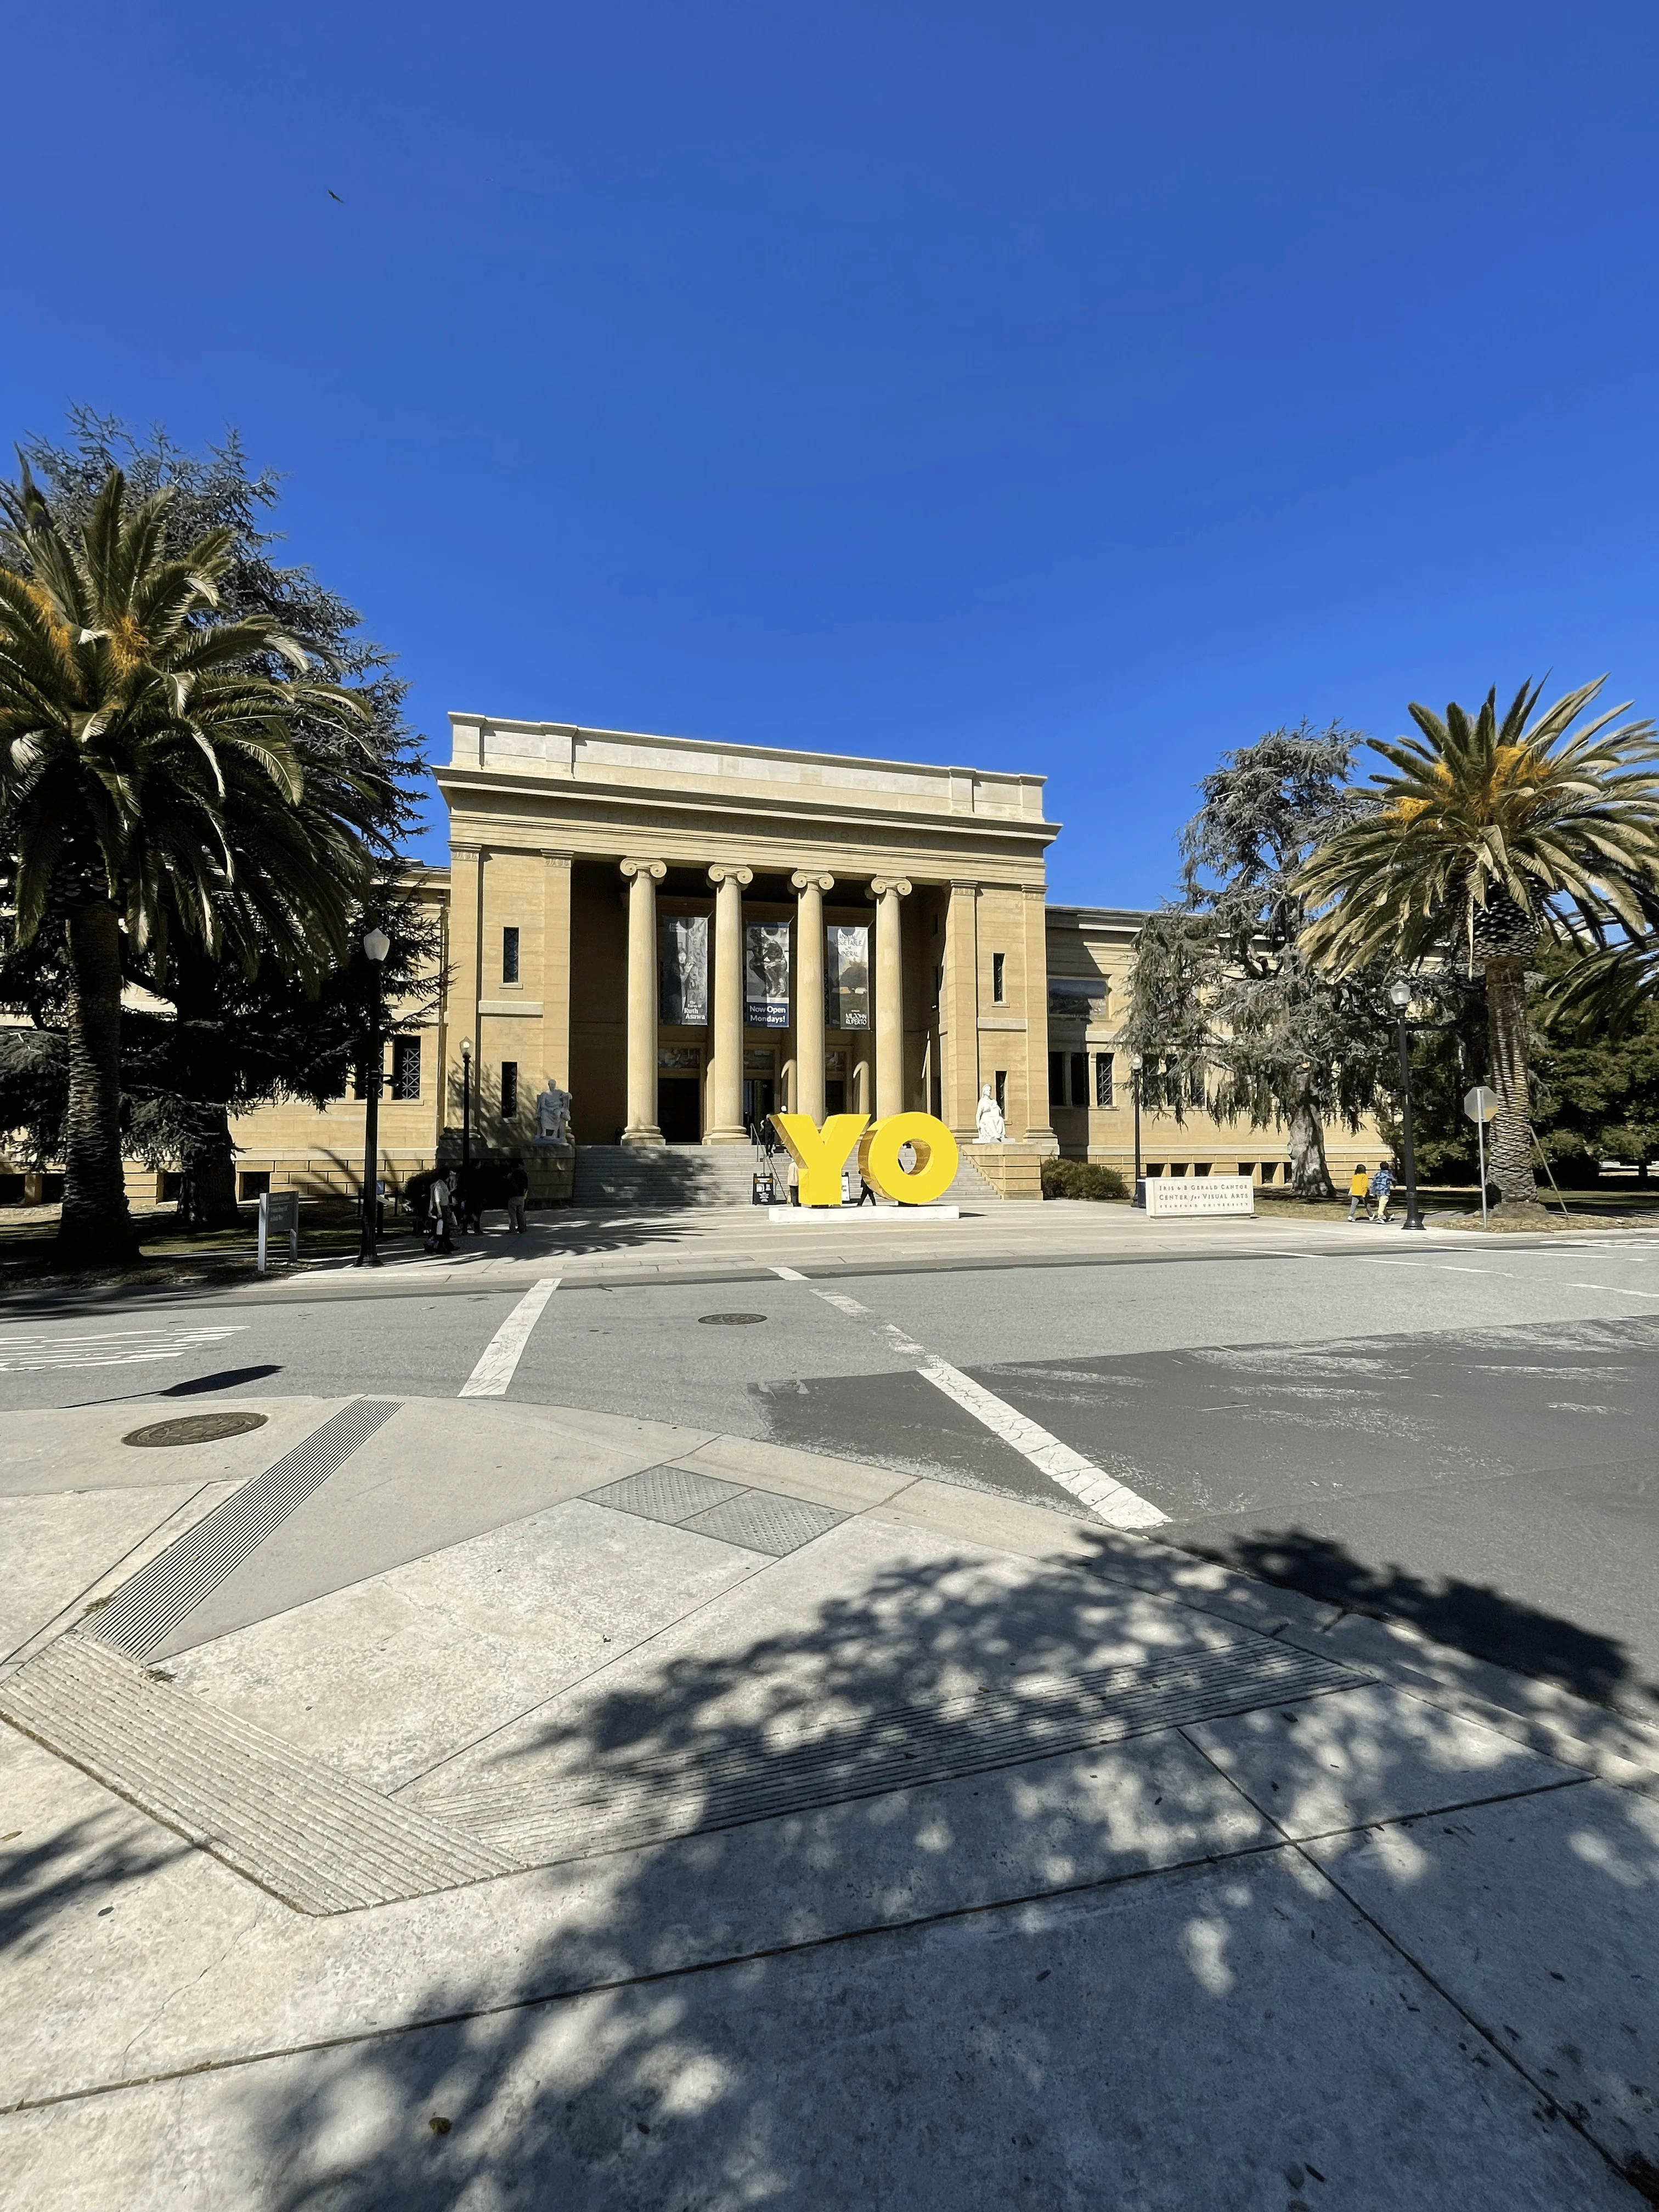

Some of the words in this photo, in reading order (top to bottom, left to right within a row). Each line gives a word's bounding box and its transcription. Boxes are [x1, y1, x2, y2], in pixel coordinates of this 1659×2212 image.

[766, 1006, 786, 1014] Open
[750, 1014, 786, 1024] Mondays!
[769, 1111, 958, 1205] YO
